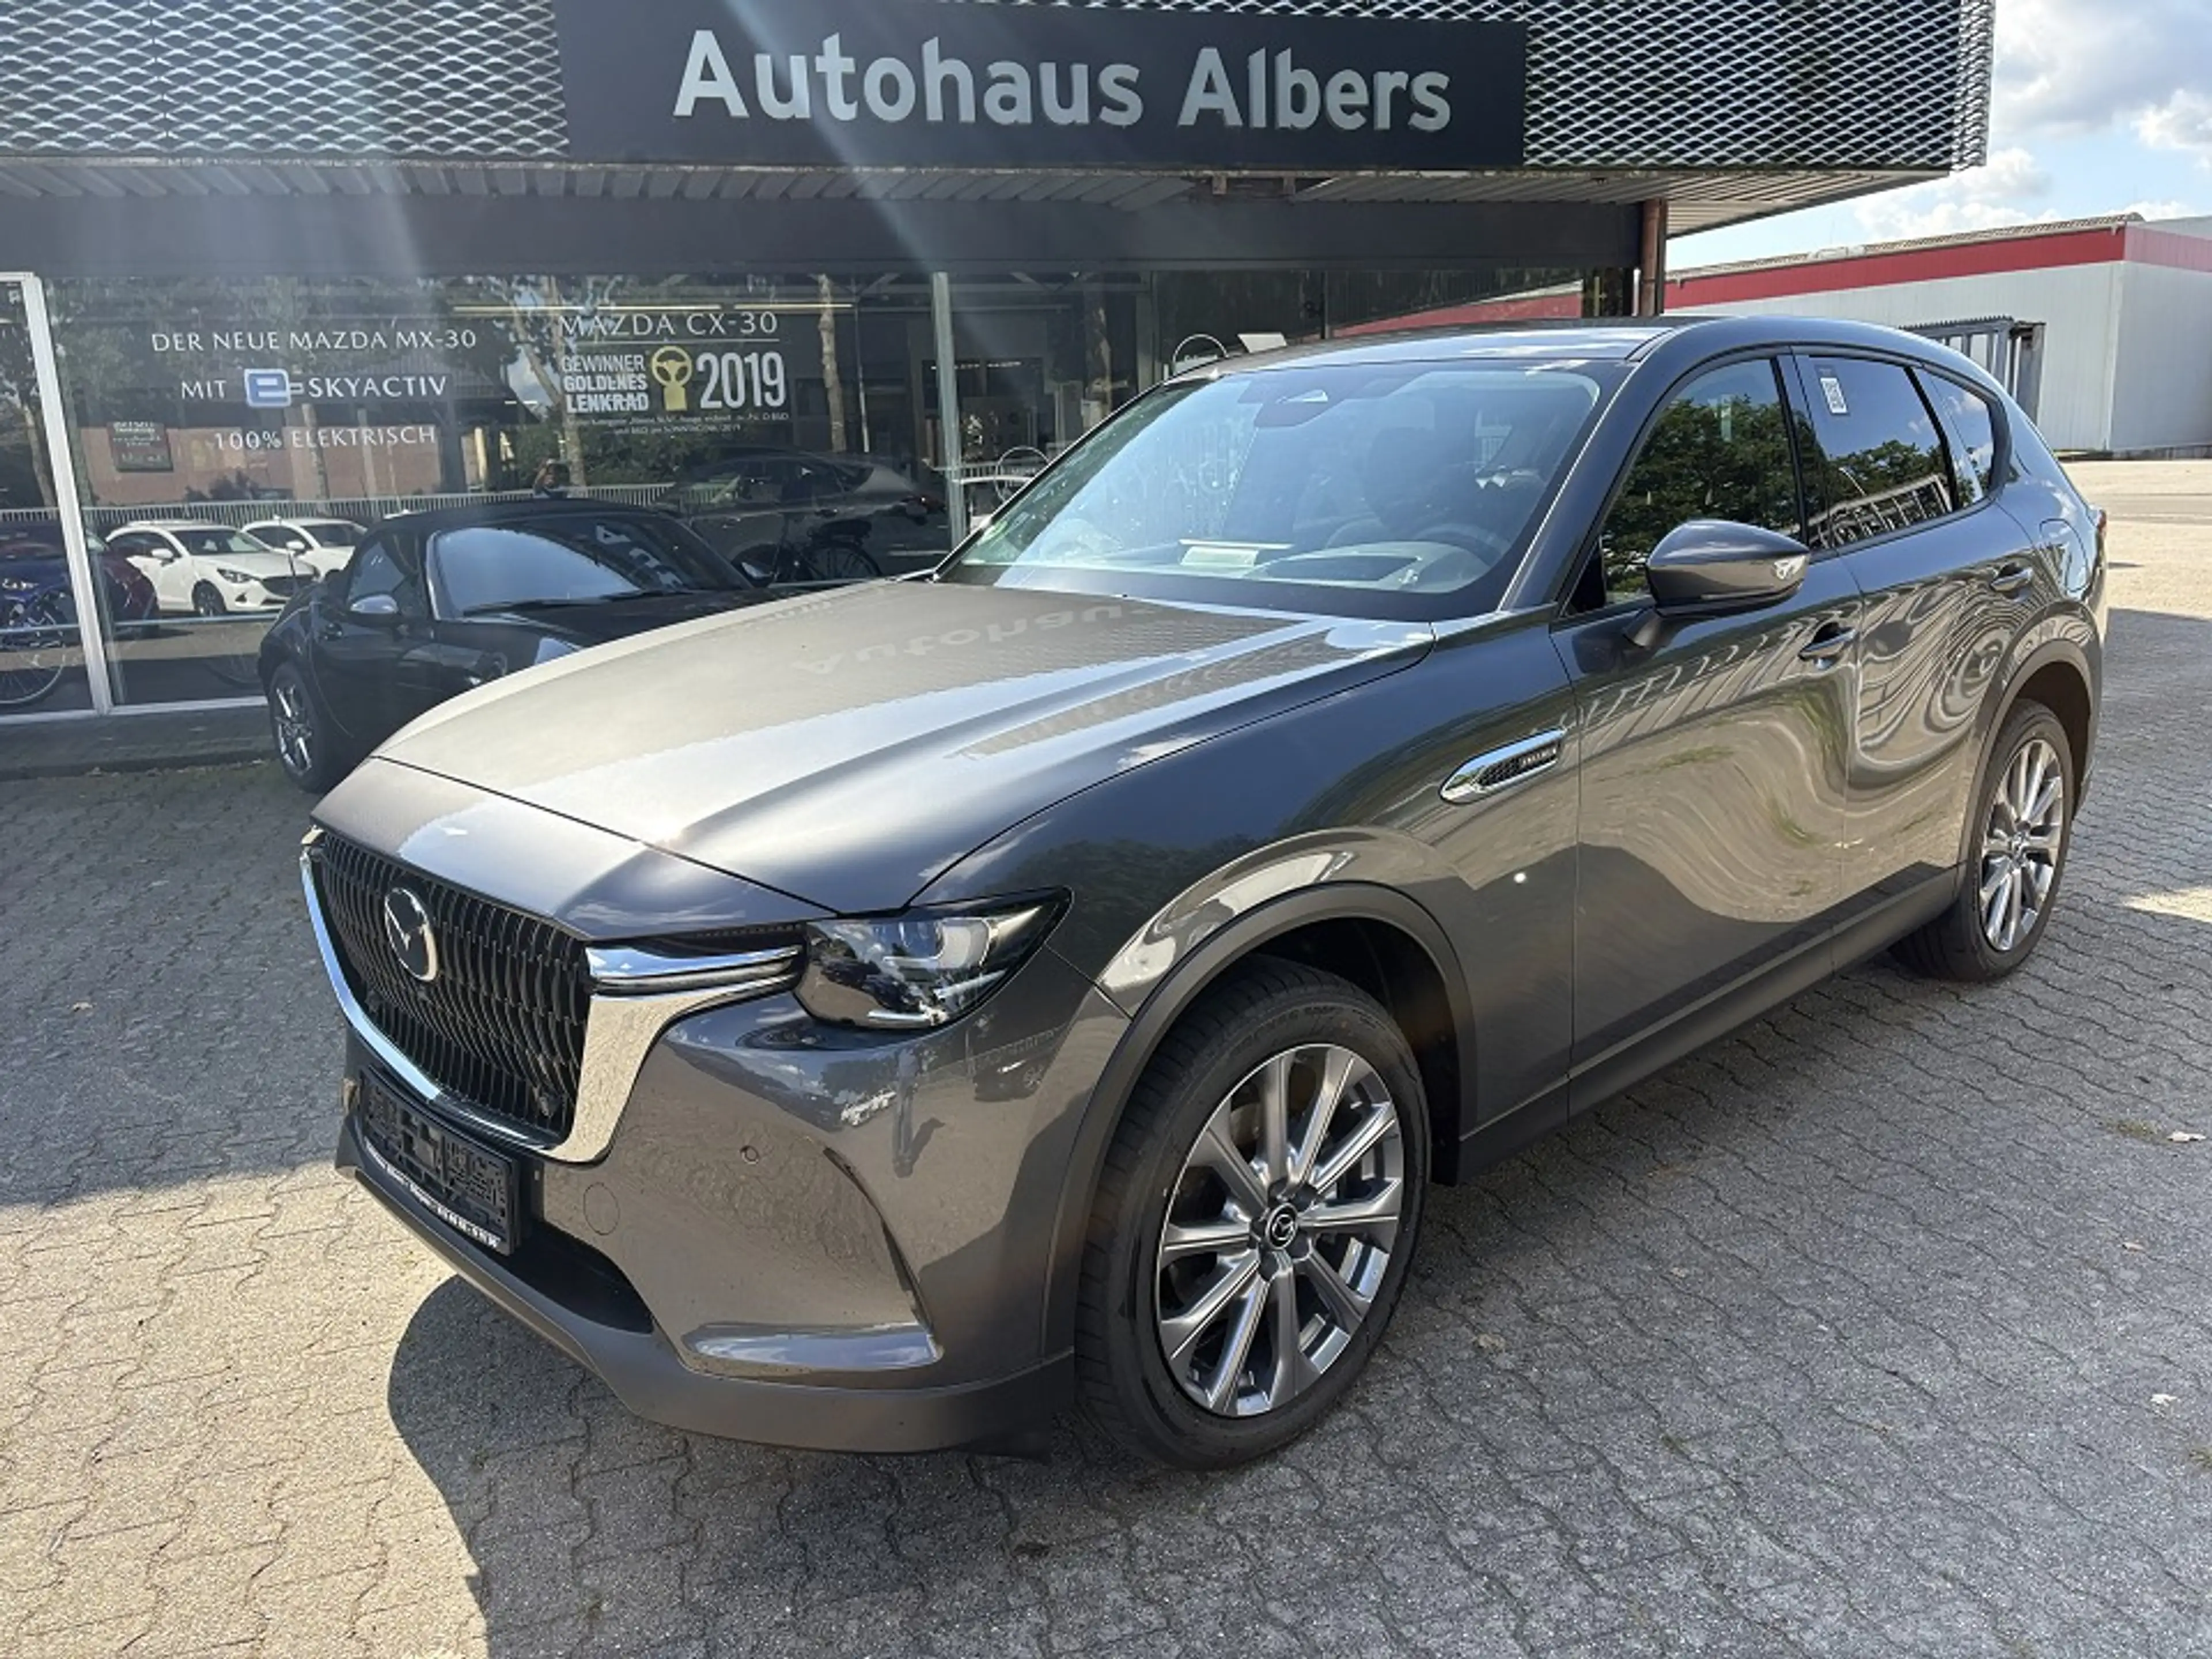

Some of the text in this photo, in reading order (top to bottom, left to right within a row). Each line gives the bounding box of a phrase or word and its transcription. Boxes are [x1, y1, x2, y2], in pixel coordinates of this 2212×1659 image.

[673, 29, 1452, 131] Autohaus Albers
[559, 310, 778, 336] MAZDA CX-30
[151, 328, 476, 351] DER NEUE MAZDA MX-30
[562, 353, 646, 373] GEWINNER
[180, 379, 228, 400] MIT
[563, 373, 648, 393] GOLDENES
[695, 351, 786, 410] 2019
[566, 392, 649, 414] LENKRAD
[214, 426, 437, 451] 100% ELEKTRISCH
